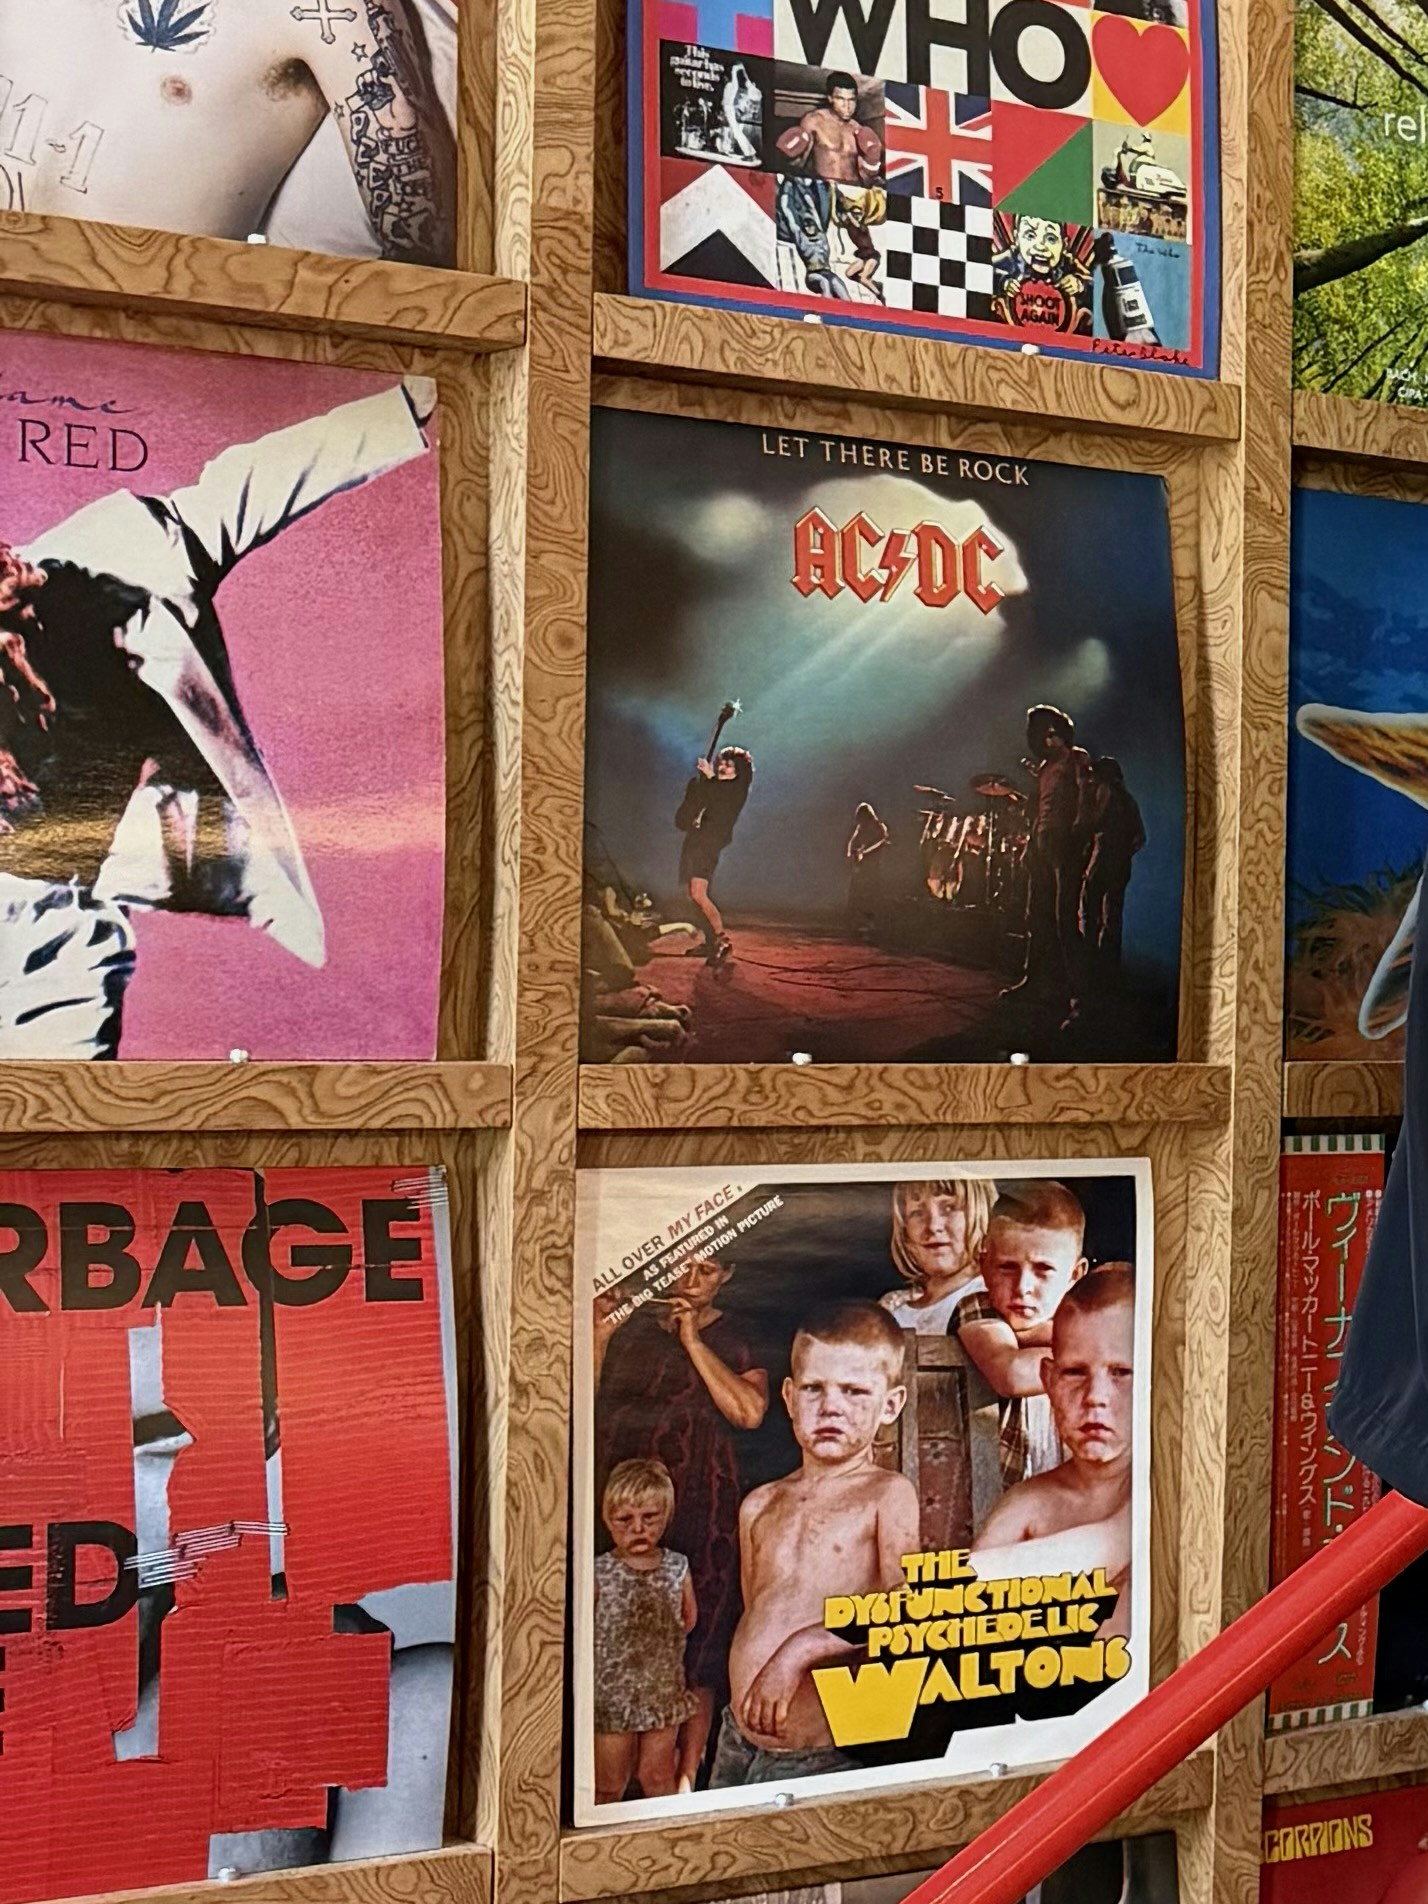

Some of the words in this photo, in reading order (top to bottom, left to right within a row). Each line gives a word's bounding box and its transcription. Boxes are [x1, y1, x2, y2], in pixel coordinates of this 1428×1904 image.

[1020, 310, 1060, 327] AGAIN
[18, 418, 148, 472] RED
[760, 432, 810, 461] LET
[819, 439, 910, 473] THERE
[920, 452, 948, 476] BE
[959, 458, 1029, 487] ROCK
[593, 1267, 622, 1293] ALL
[621, 1235, 666, 1272] OVER
[667, 1213, 692, 1241] MY
[694, 1184, 735, 1221] FACE
[643, 1257, 660, 1282] AS
[659, 1225, 716, 1270] FEATURED
[713, 1214, 730, 1231] IN
[693, 1230, 739, 1265] MOTION
[737, 1194, 785, 1234] PICTURE
[901, 1549, 971, 1584] THE
[824, 1568, 1119, 1629] DYSFUNCTIONAL
[868, 1603, 1099, 1658] PSYCHEDELIC
[811, 1636, 1131, 1747] WALTONS
[1261, 1813, 1374, 1867] CORPIONS
